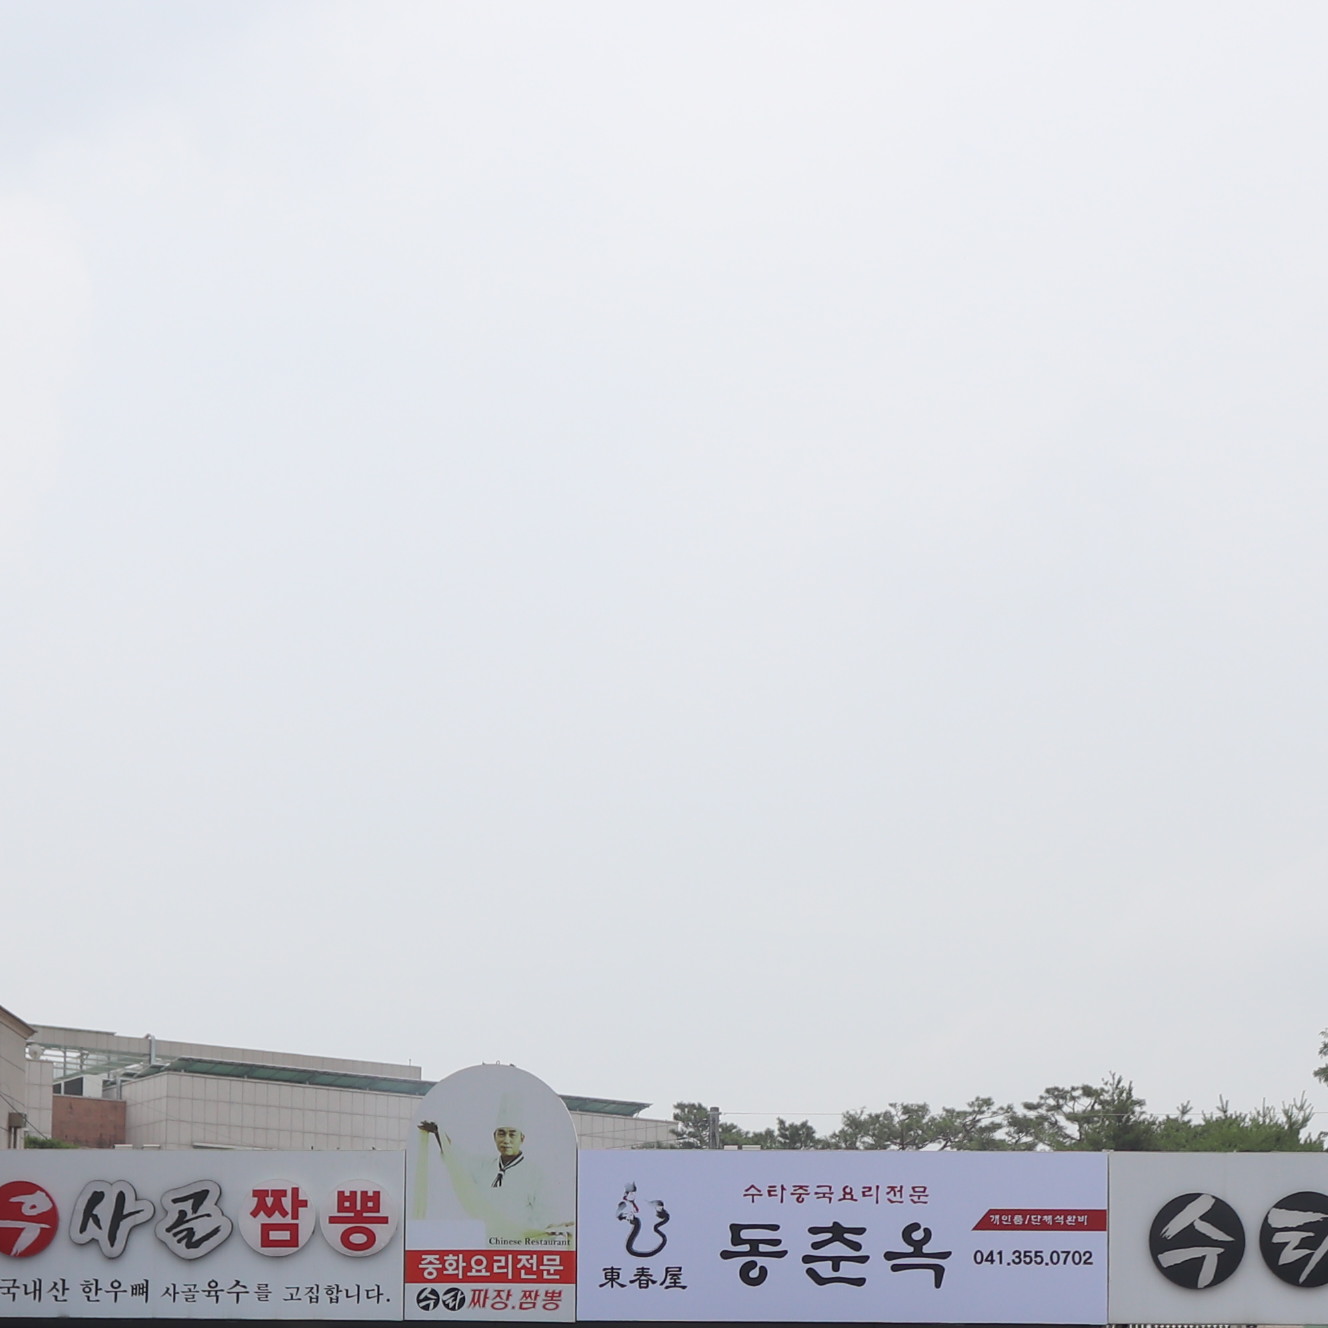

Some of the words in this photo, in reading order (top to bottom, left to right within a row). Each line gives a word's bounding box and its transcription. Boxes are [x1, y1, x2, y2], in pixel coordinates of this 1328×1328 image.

[743, 1184, 930, 1205] 수타중국요리전문
[489, 1237, 522, 1246] Chinese
[525, 1237, 571, 1246] Restaurant
[418, 1254, 564, 1279] 중화요리전문
[720, 1222, 952, 1289] 동춘옥
[973, 1250, 1094, 1268] 041.355.0702
[598, 1265, 688, 1291] 東春屋
[81, 1278, 149, 1304] 한우뼈
[163, 1279, 272, 1304] 사골육수를
[283, 1284, 391, 1305] 고집합니다.
